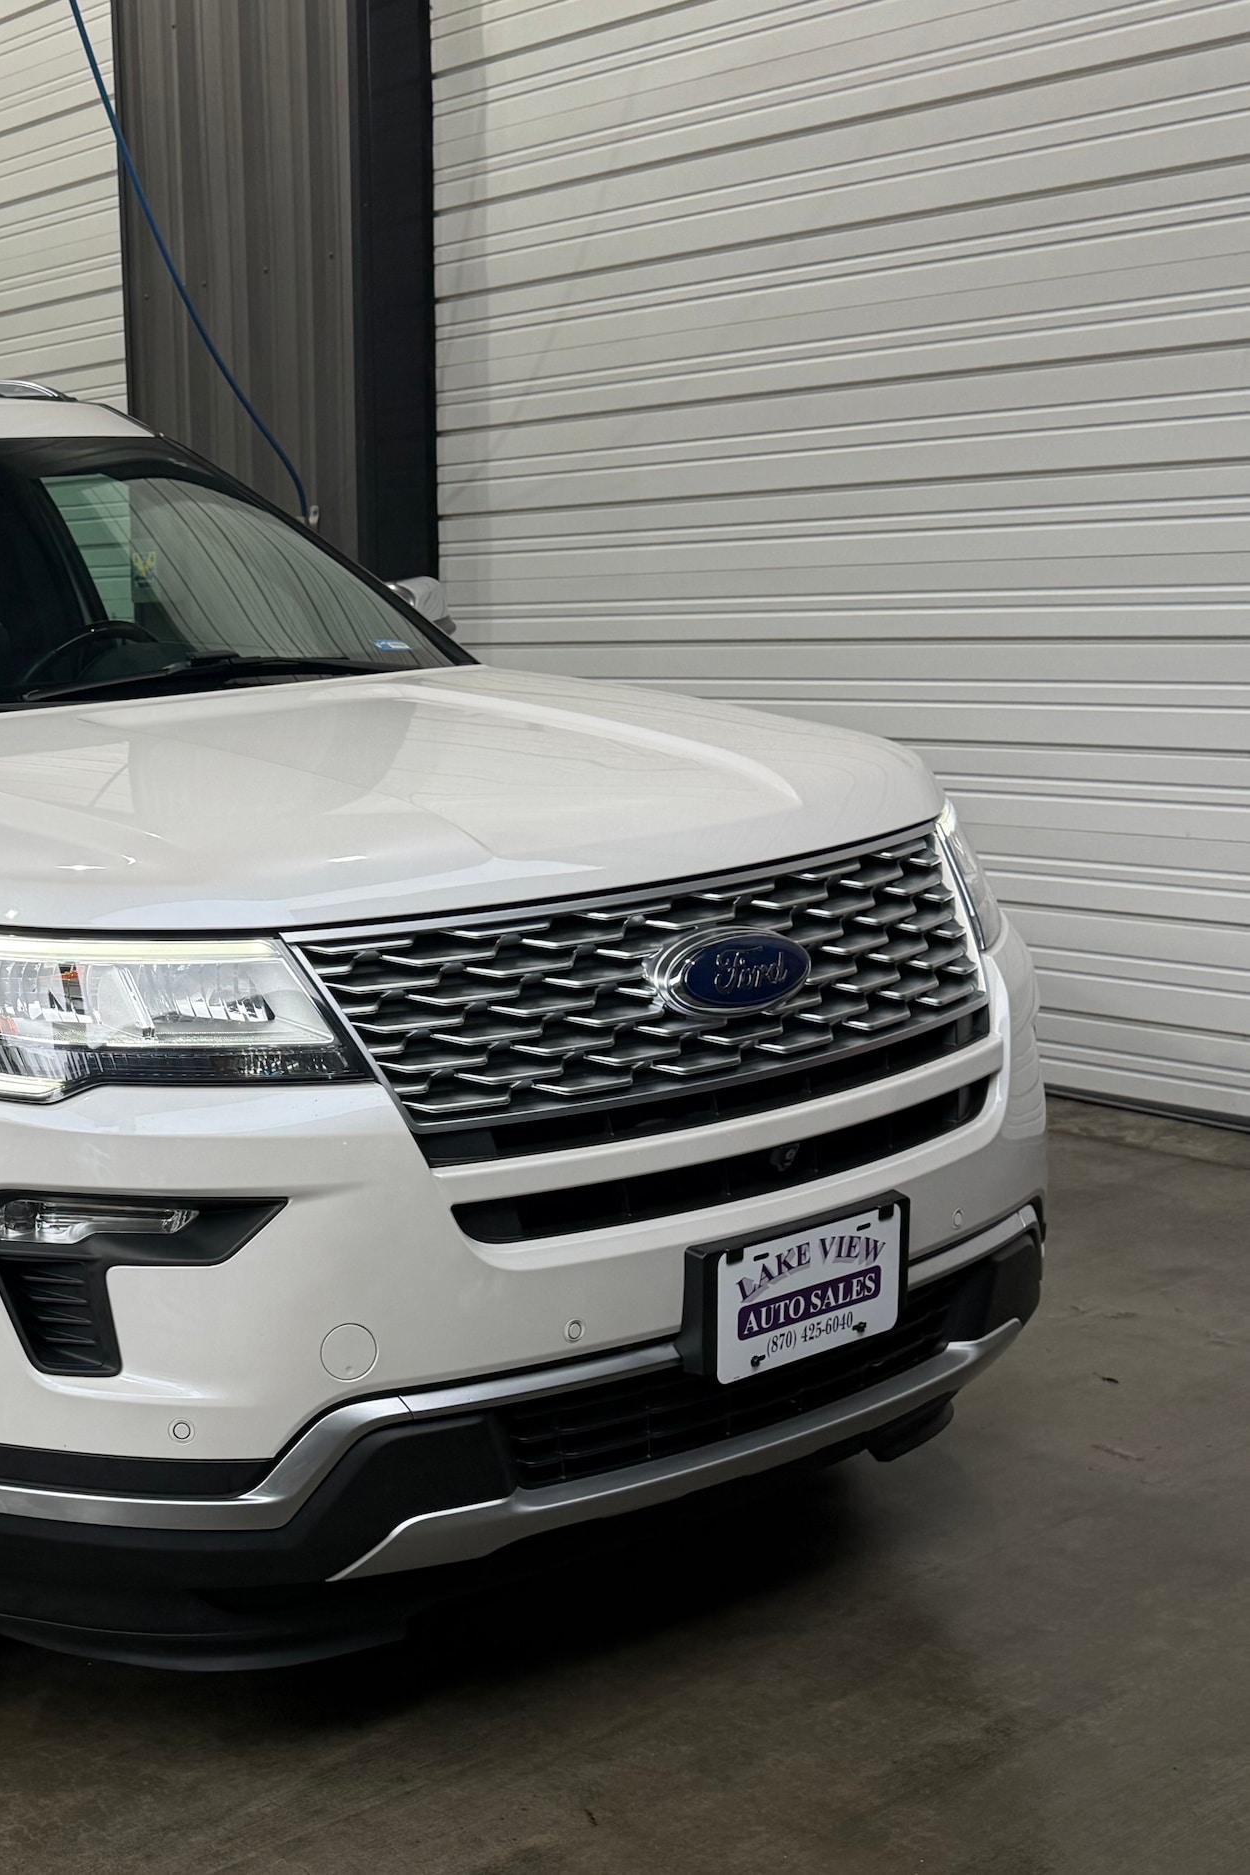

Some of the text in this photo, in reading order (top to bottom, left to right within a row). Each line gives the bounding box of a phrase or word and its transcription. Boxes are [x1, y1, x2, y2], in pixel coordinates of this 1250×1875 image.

[714, 946, 788, 995] Ford
[736, 1235, 886, 1303] LAKE VIEW
[743, 1273, 876, 1335] AUTO SALES
[766, 1311, 854, 1357] (870) 425-6040
